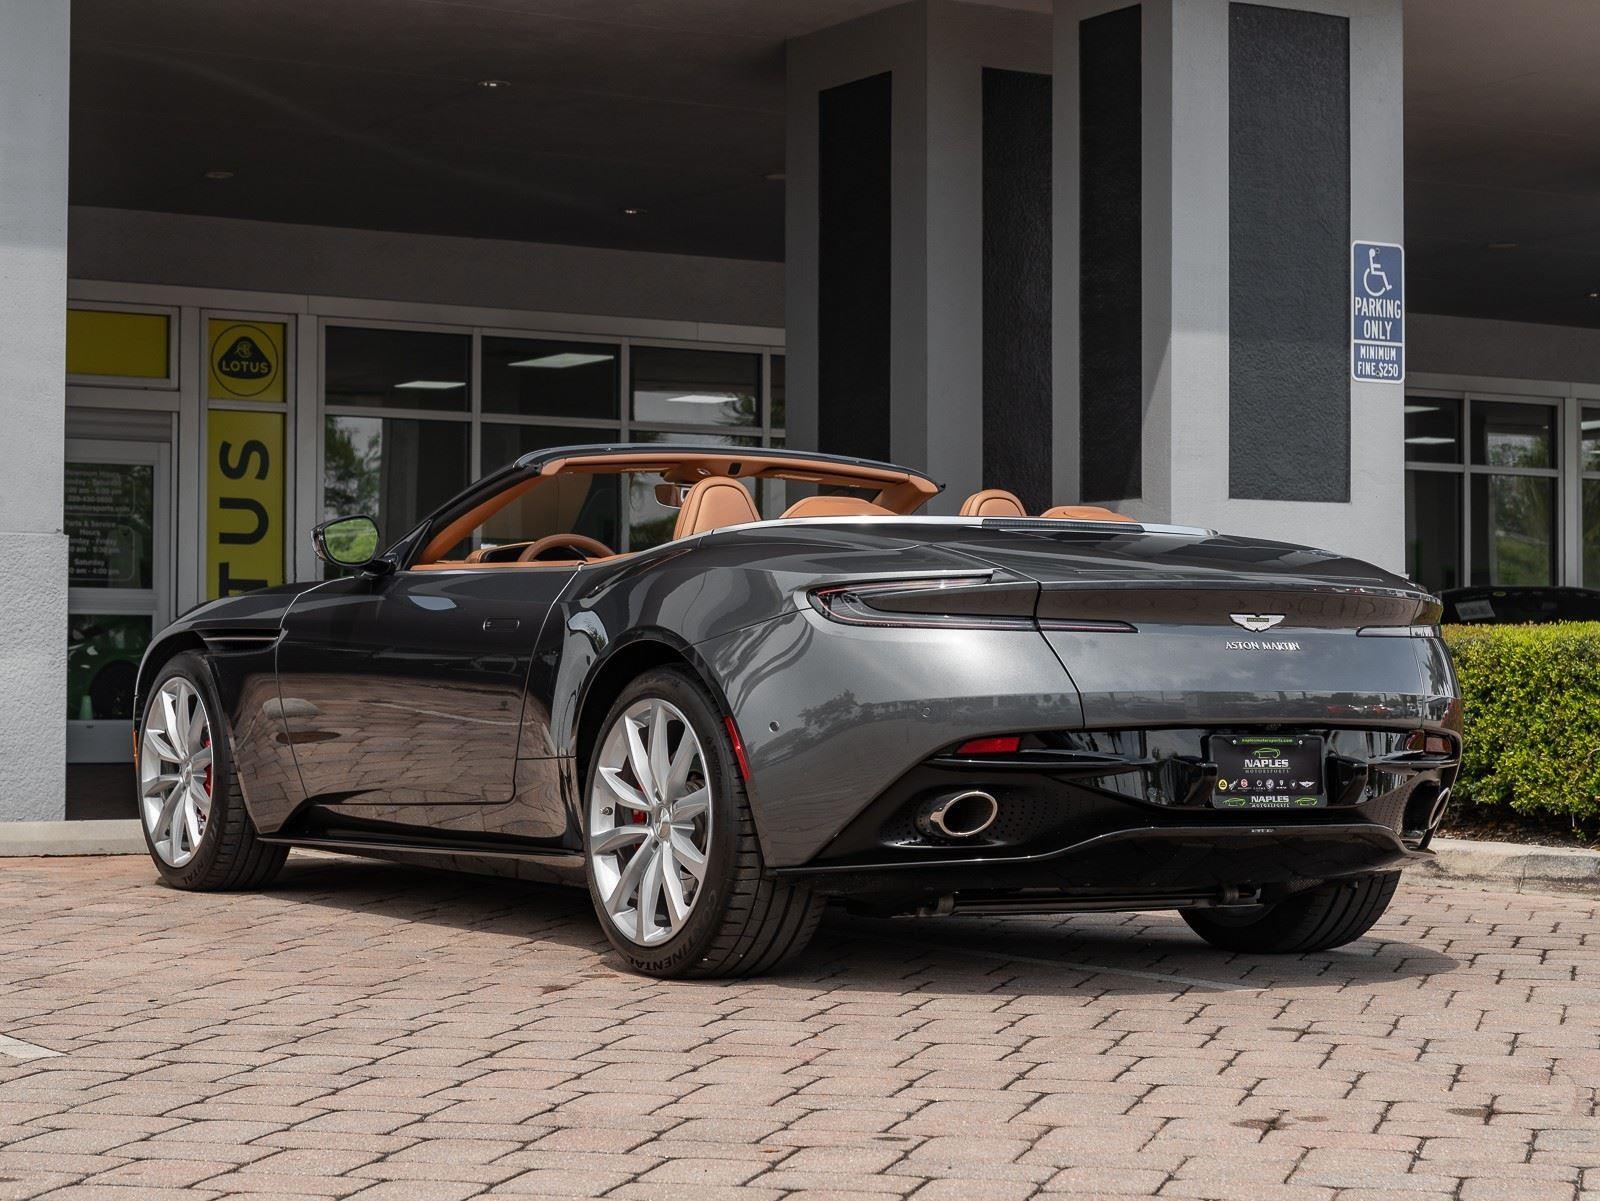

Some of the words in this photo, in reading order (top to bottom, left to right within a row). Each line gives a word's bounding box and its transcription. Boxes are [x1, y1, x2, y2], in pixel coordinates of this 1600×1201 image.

[1354, 297, 1402, 319] PARKING
[1363, 319, 1393, 340] ONLY
[1360, 345, 1397, 361] MINIMUM
[221, 360, 270, 374] LOTUS
[1357, 361, 1377, 376] FINE
[1379, 361, 1399, 378] $250
[1226, 641, 1260, 651] ASTON
[1261, 641, 1301, 651] MARTIN
[1244, 759, 1290, 768] NAPLES
[1251, 795, 1290, 803] NAPLES
